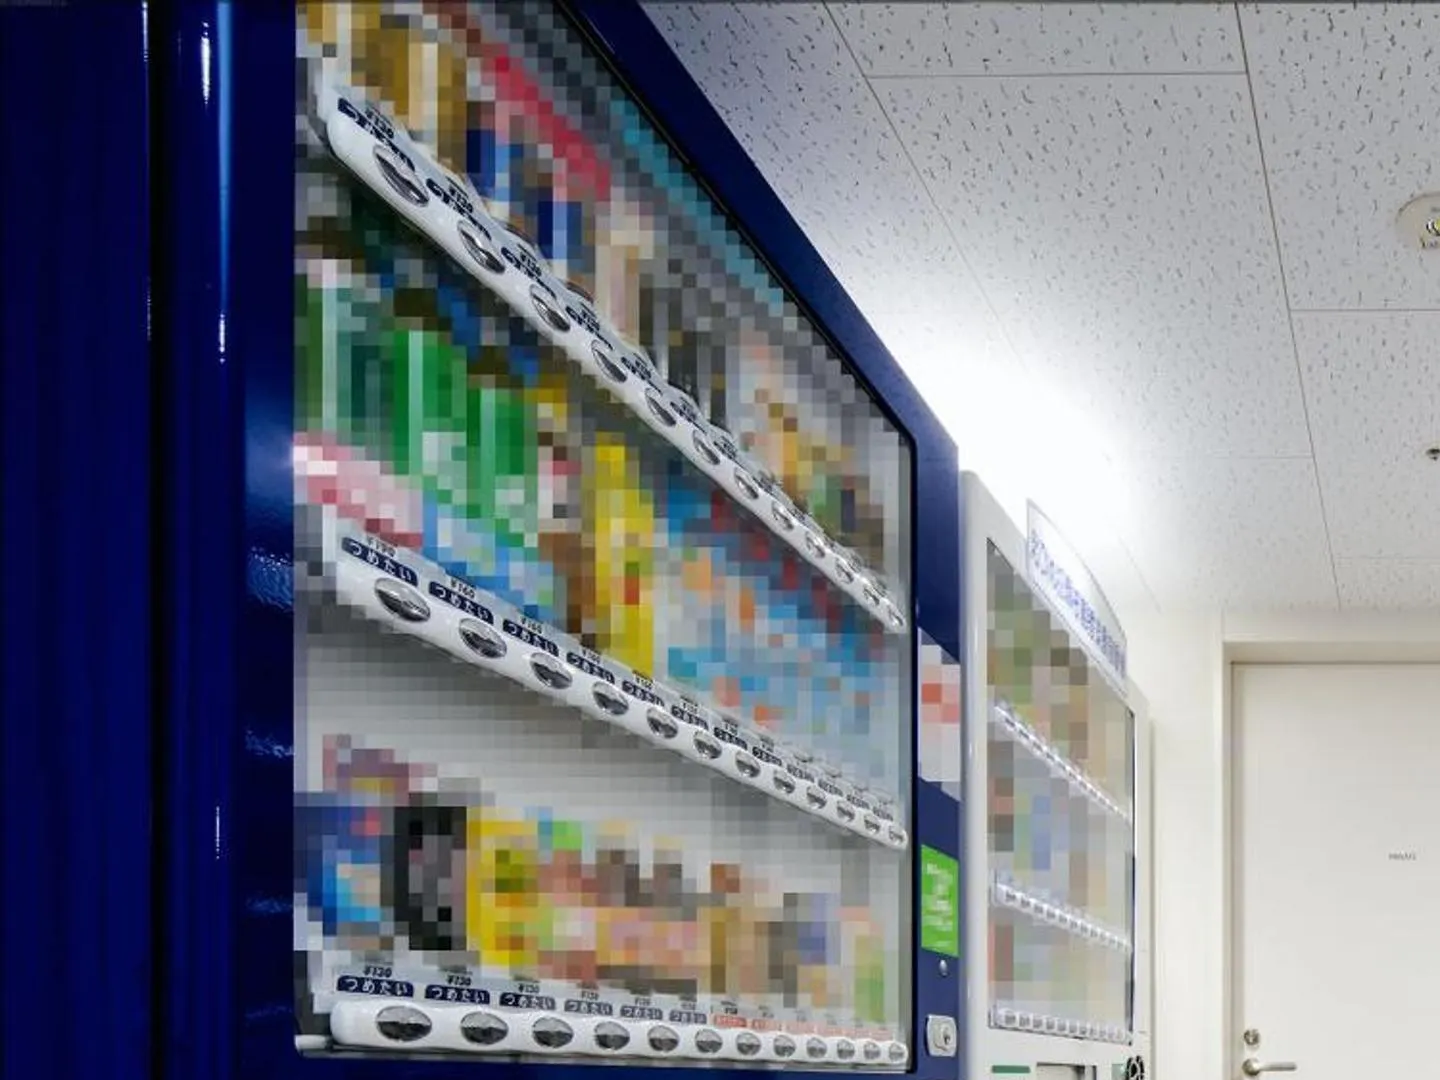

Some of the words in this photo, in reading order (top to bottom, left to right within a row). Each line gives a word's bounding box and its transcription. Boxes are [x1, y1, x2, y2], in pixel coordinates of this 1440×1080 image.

[343, 539, 415, 583] つめたい
[363, 964, 392, 979] ¥130
[446, 973, 472, 987] ¥130
[344, 977, 409, 996] つめたい
[430, 986, 486, 1004] つめたい
[502, 994, 554, 1010] つめたい
